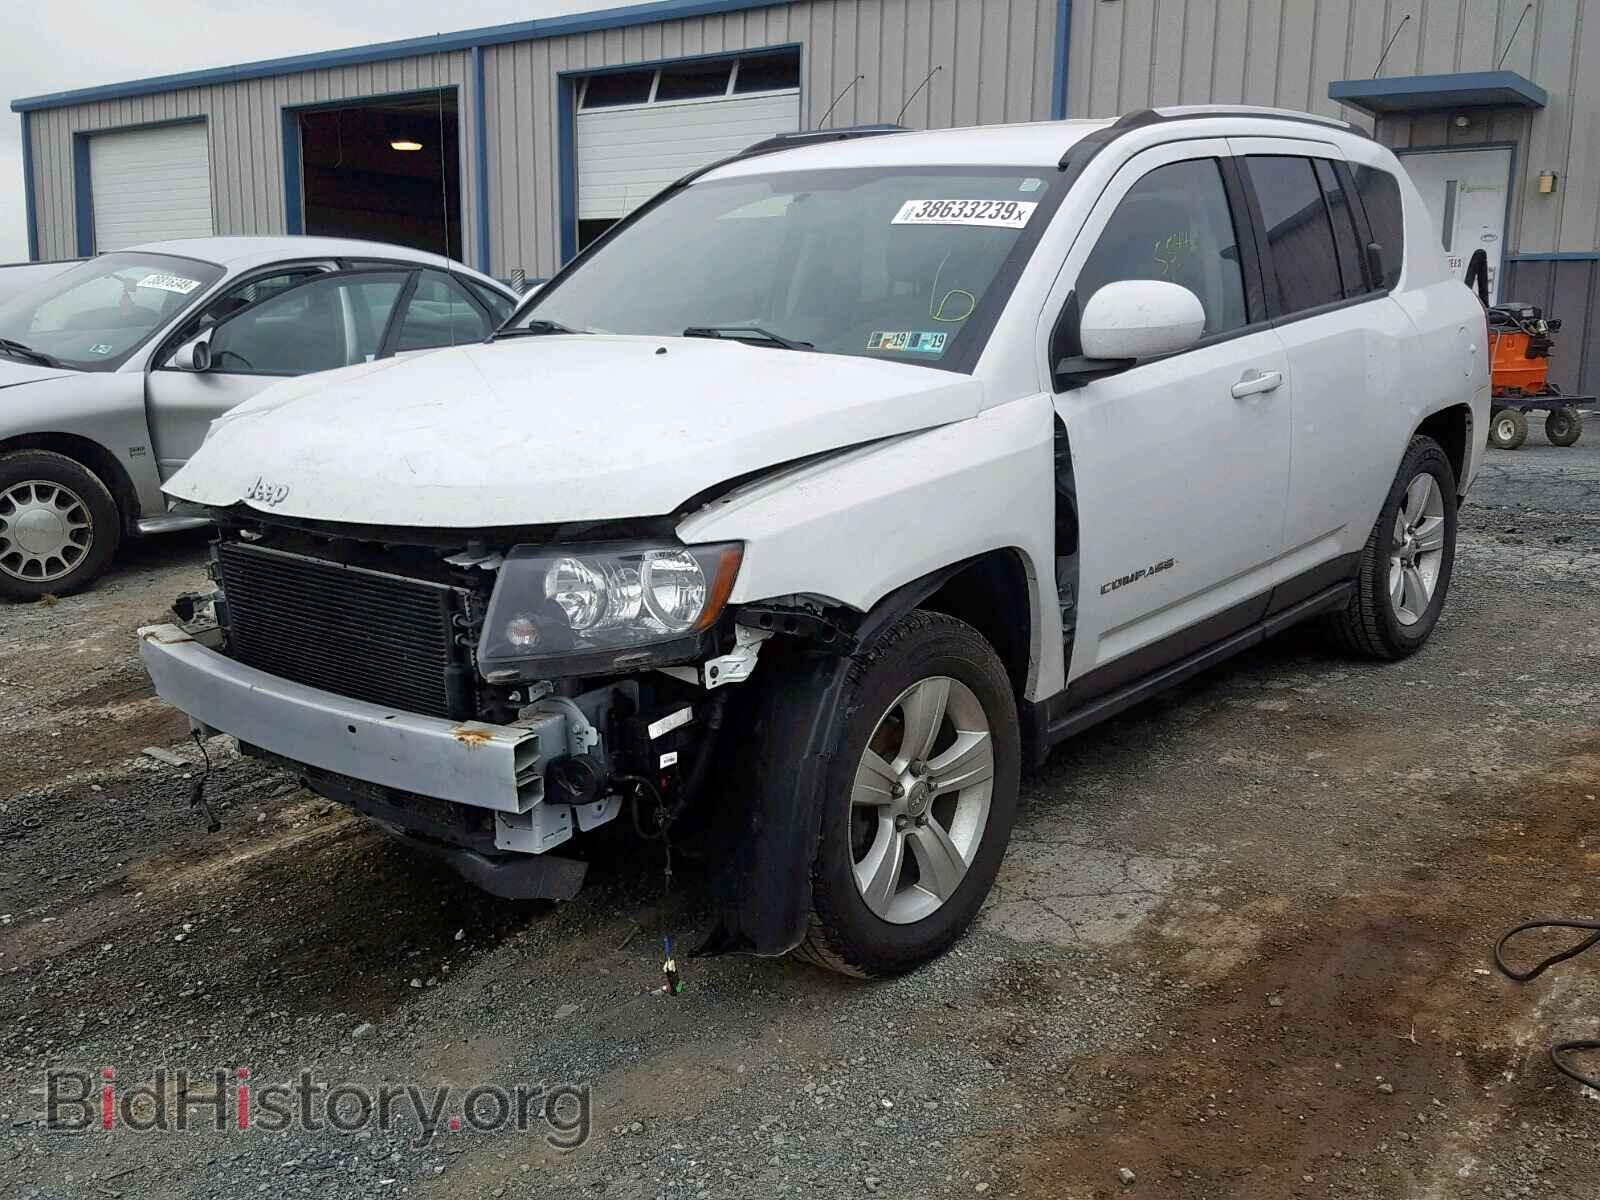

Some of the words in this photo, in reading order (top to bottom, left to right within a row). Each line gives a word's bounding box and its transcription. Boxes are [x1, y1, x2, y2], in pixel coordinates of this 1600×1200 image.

[931, 334, 945, 348] 19
[244, 476, 290, 507] Jeep
[1100, 557, 1175, 595] COMPASS
